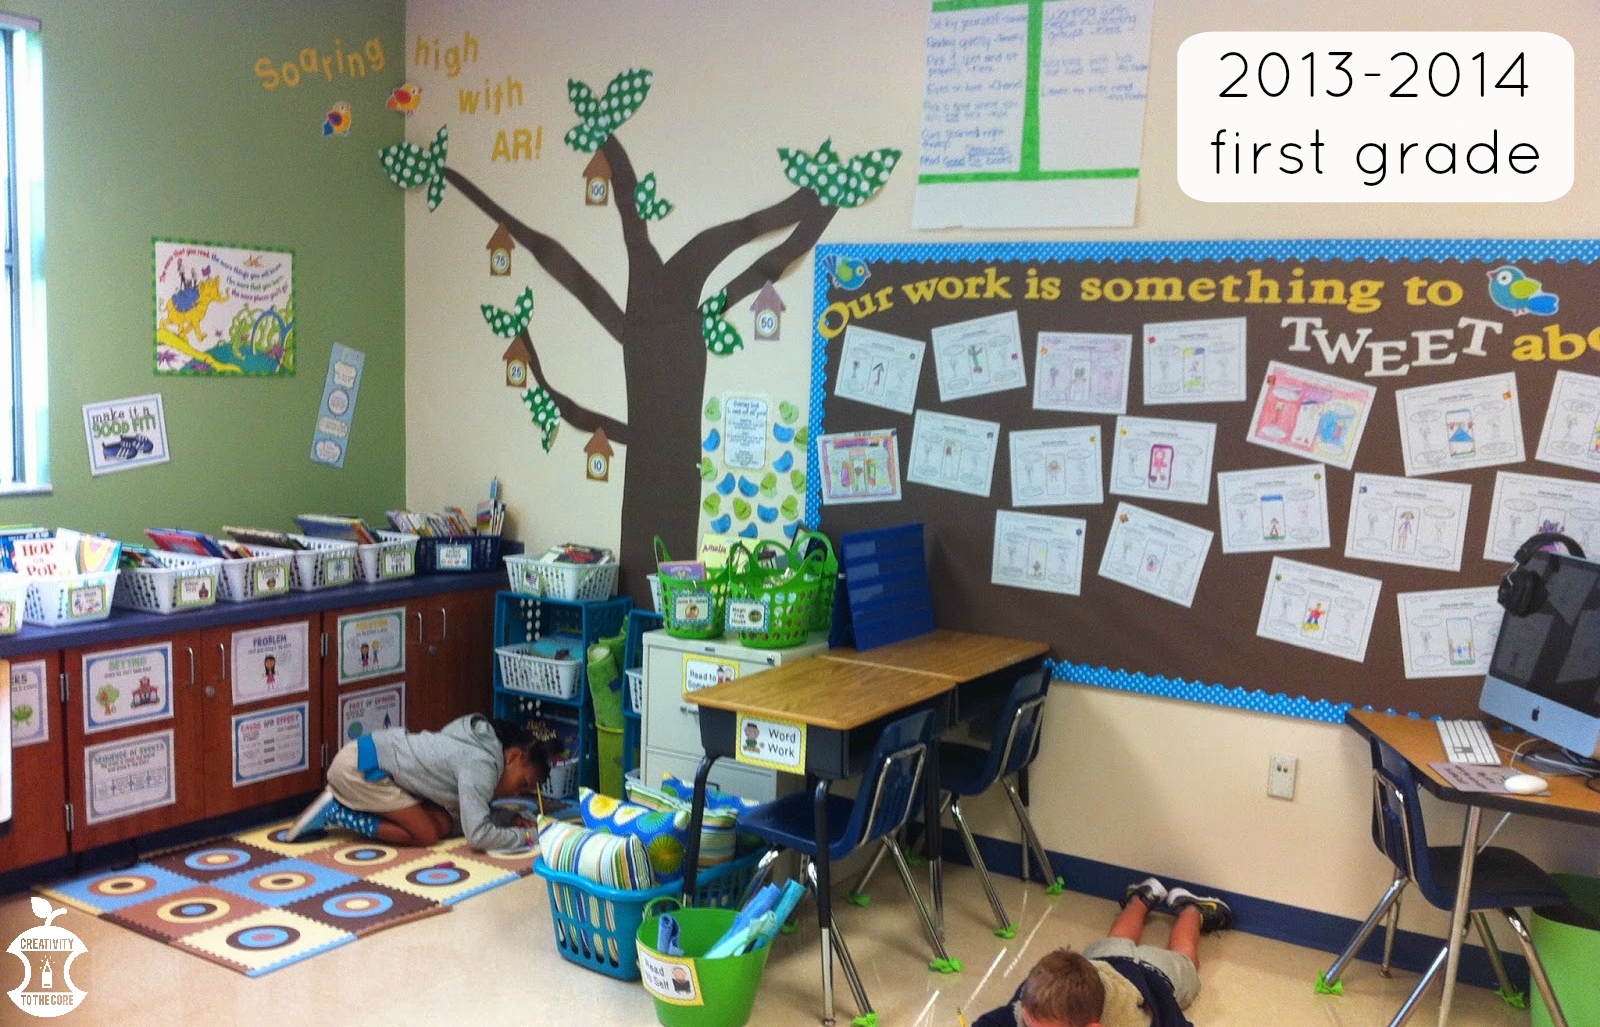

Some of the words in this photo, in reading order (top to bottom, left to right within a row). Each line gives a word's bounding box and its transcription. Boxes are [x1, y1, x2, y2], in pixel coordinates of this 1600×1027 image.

[255, 38, 386, 90] Soaring
[414, 31, 479, 79] high
[459, 75, 523, 115] with
[491, 126, 543, 162] AR!
[591, 185, 605, 196] 100
[495, 256, 506, 266] 75
[818, 285, 894, 339] Our
[902, 267, 1013, 305] work
[1024, 268, 1062, 300] is
[1080, 268, 1384, 314] something
[1403, 275, 1464, 307] to
[761, 317, 774, 329] 50
[1281, 316, 1503, 377] TWEET
[511, 366, 522, 377] 25
[593, 459, 602, 471] 10
[21, 542, 54, 557] HOP
[26, 562, 57, 576] POP
[253, 634, 287, 647] PROBLEM
[689, 668, 708, 680] Read
[709, 673, 717, 682] to
[768, 727, 796, 743] Word
[767, 742, 795, 758] Work
[645, 958, 665, 977] Read
